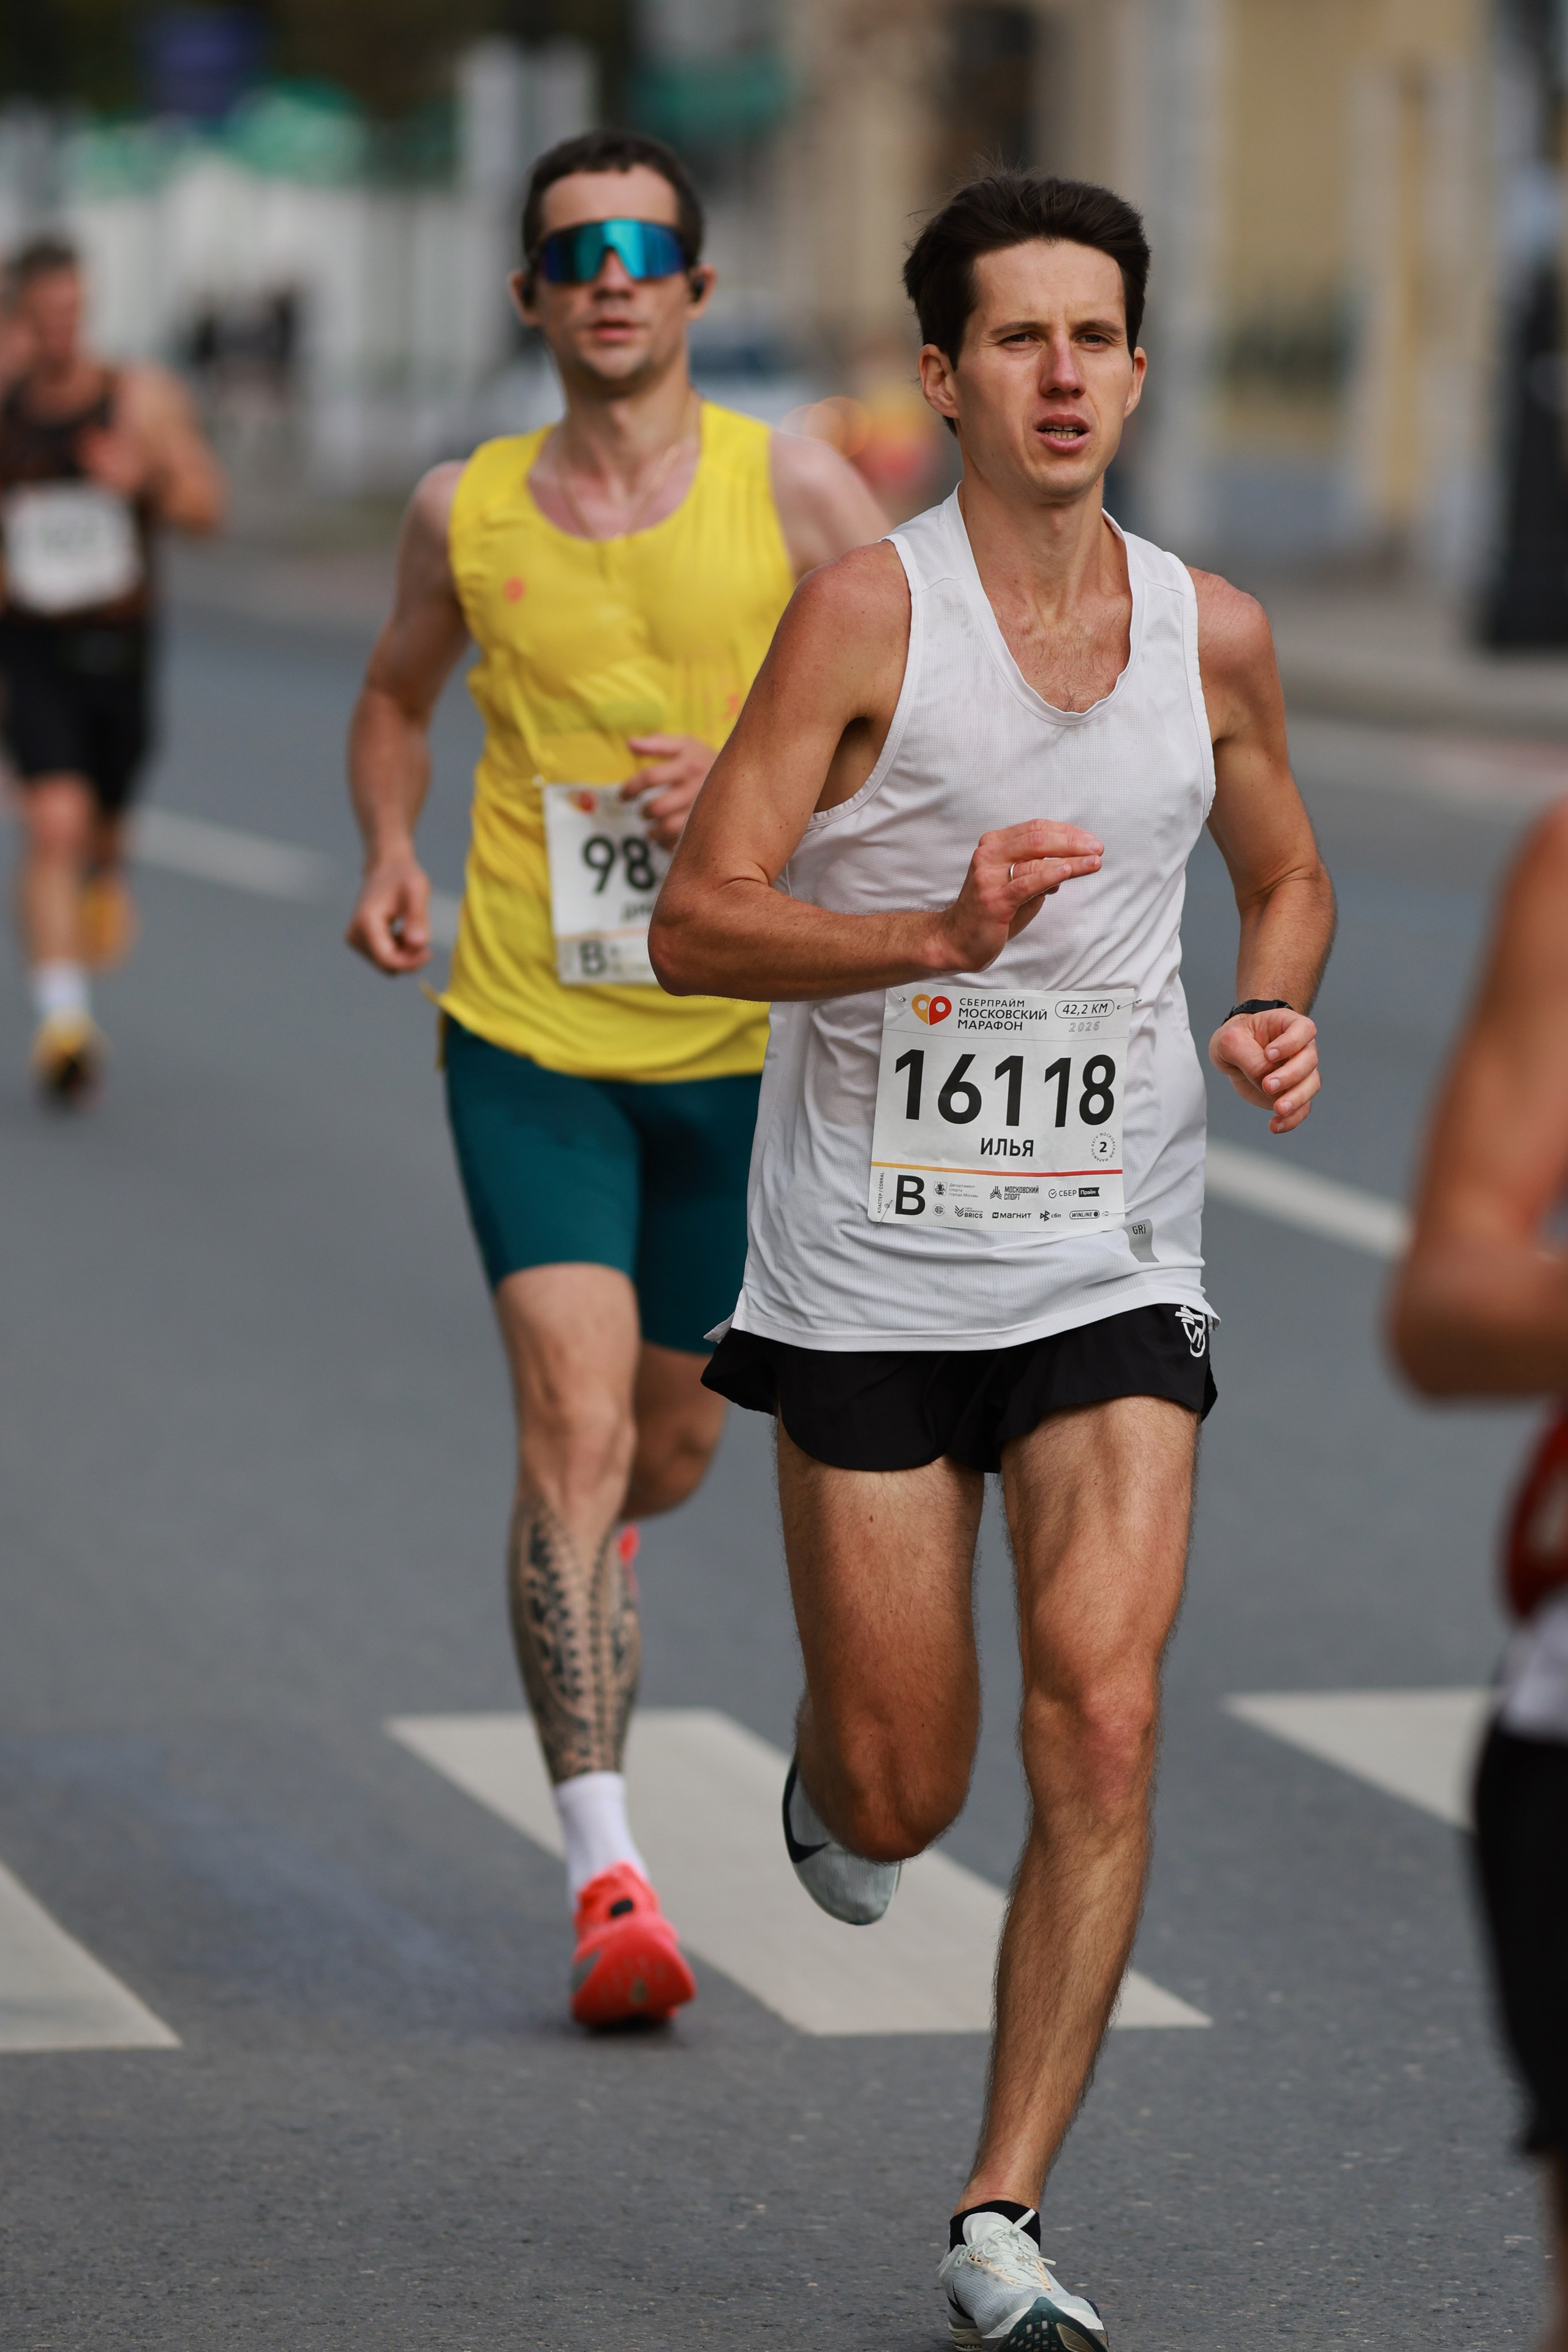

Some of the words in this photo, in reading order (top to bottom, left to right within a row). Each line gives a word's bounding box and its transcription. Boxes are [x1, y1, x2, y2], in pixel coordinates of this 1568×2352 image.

[960, 998, 1025, 1008] СБЕРПРАЙМ
[959, 1008, 1047, 1020] МОСКОВСКИЙ
[1062, 1004, 1088, 1017] 42,2
[1091, 1003, 1109, 1014] КМ
[957, 1020, 1023, 1031] МАРАФОН
[1069, 1021, 1100, 1033] 2026
[895, 1049, 1116, 1128] 16118
[980, 1137, 1035, 1157] ИЛЬЯ
[1099, 1141, 1107, 1153] 2
[895, 1174, 925, 1216] B
[1005, 1185, 1039, 1194] МОСКОВСКИЙ
